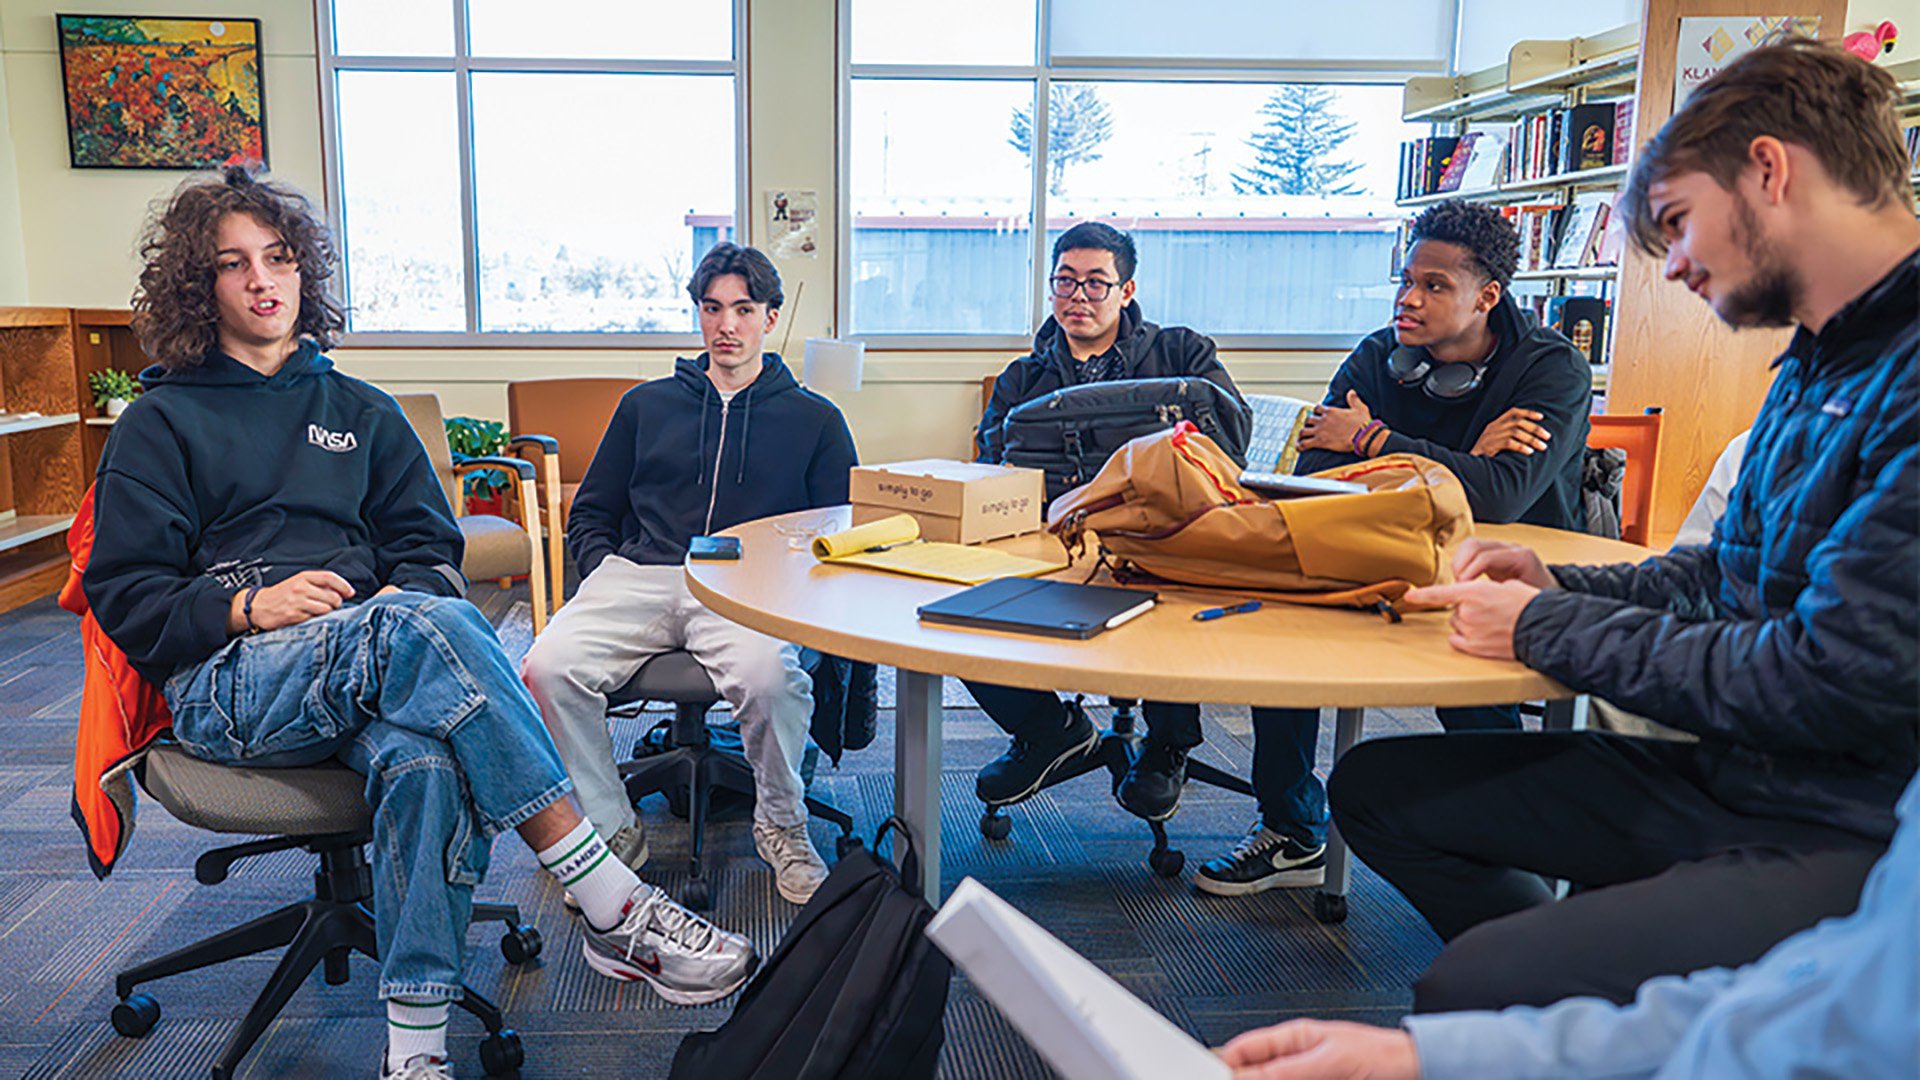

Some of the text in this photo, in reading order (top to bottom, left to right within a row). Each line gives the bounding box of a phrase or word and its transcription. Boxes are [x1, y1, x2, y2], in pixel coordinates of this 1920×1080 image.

[308, 423, 358, 449] NASA
[878, 483, 934, 503] simply to go
[981, 497, 1030, 516] simply to go
